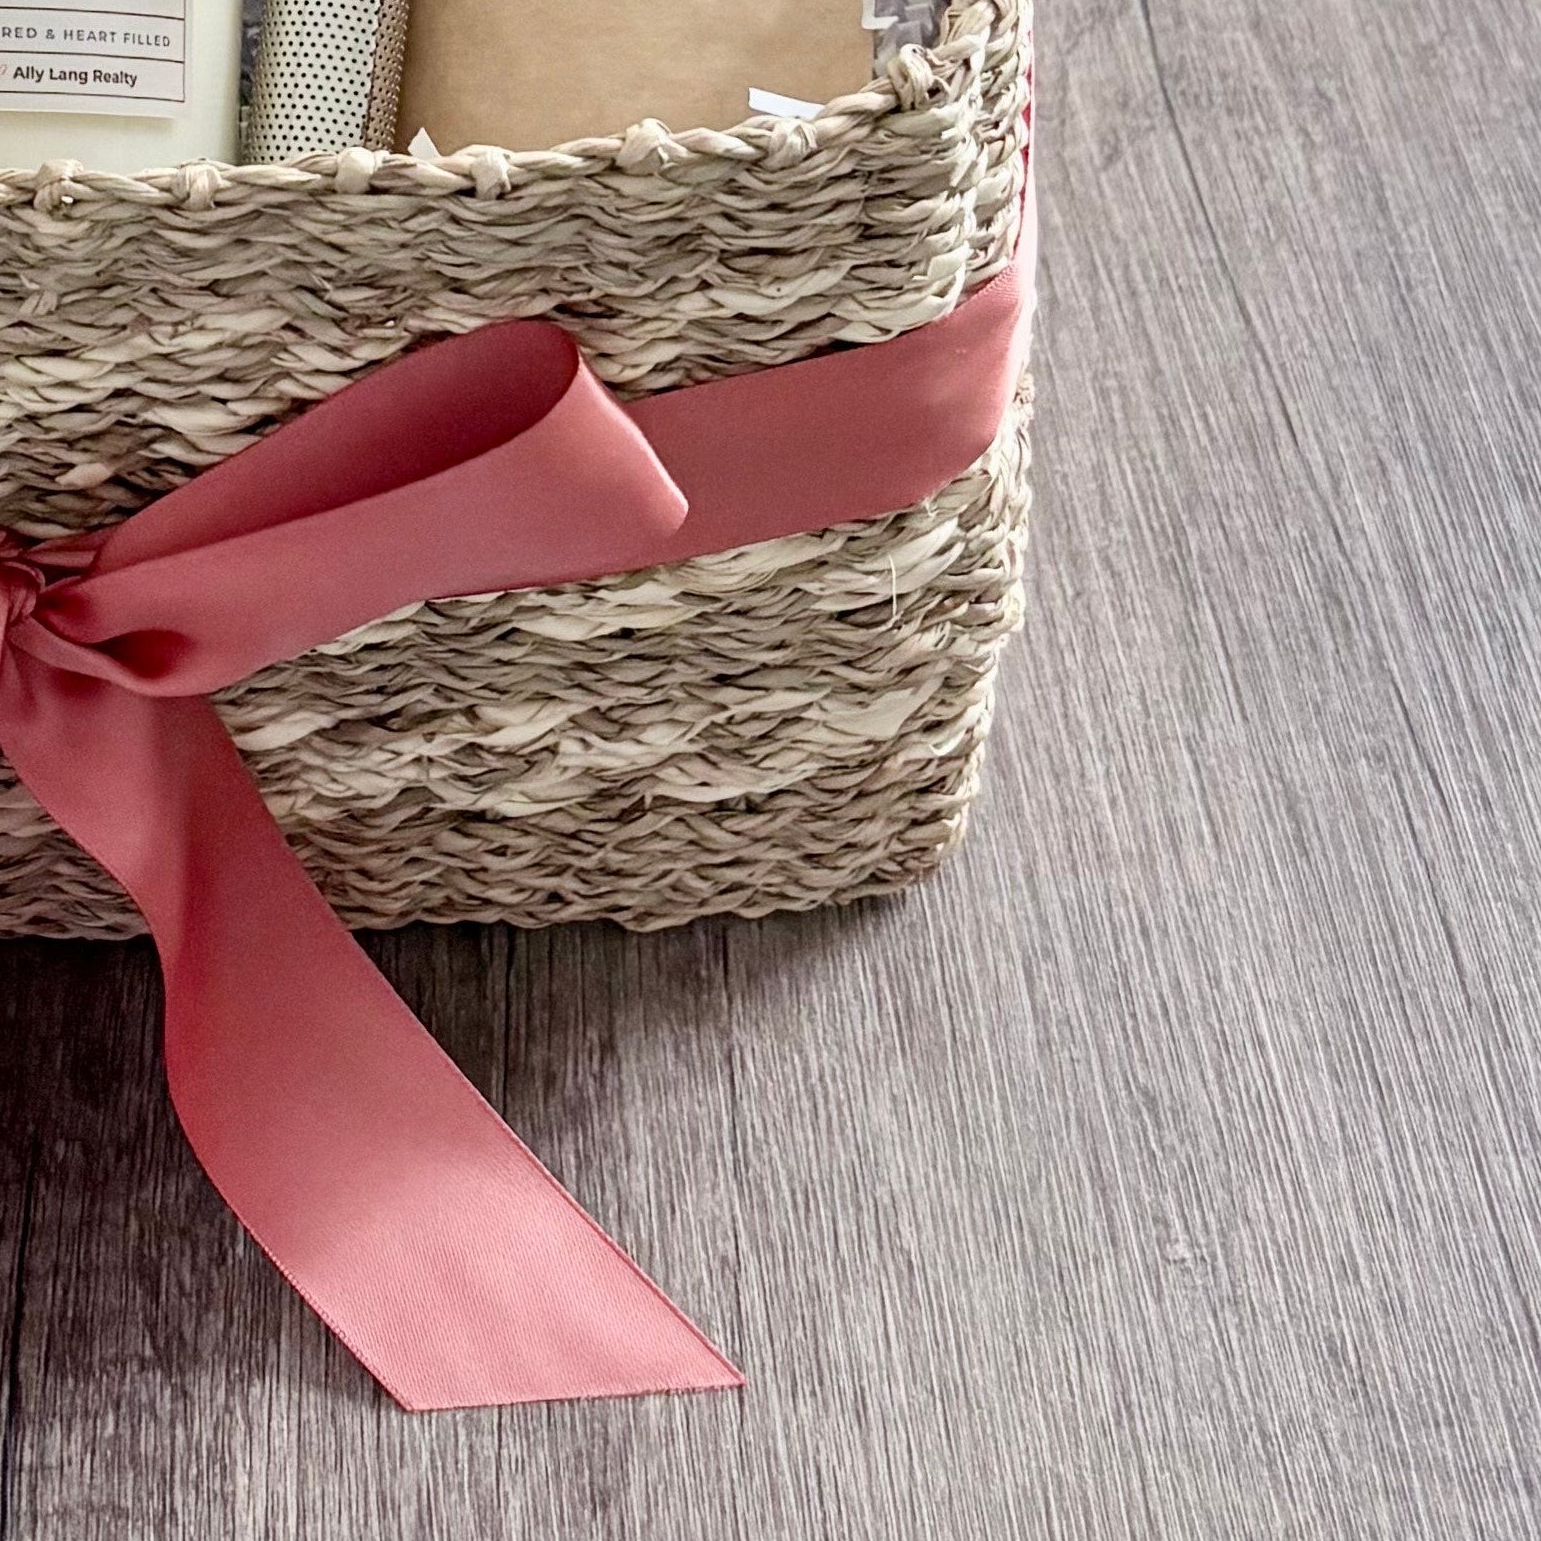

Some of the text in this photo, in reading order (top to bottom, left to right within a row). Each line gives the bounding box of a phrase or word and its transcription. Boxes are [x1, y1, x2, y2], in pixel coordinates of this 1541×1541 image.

[45, 28, 56, 40] &
[63, 29, 118, 43] HEART
[123, 32, 171, 47] FILLED
[13, 65, 138, 88] Ally Lang Realty
